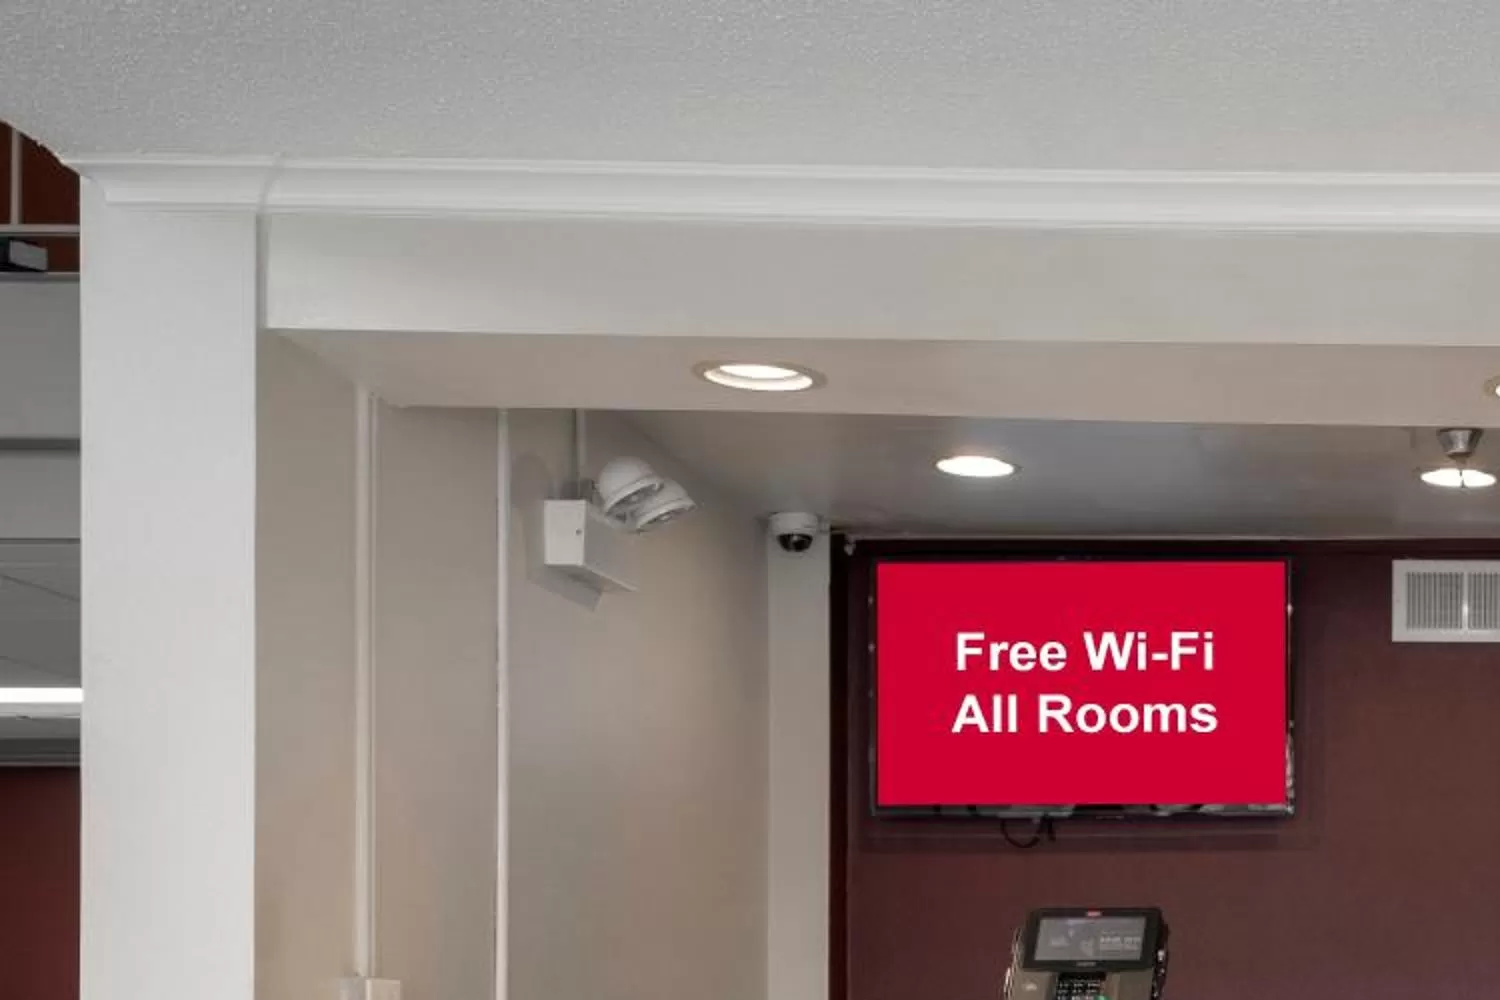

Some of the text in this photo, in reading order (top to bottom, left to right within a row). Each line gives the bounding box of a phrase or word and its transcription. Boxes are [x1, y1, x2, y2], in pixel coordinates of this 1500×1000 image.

[956, 631, 1214, 672] Free Wi-Fi
[951, 693, 1218, 734] All Rooms
